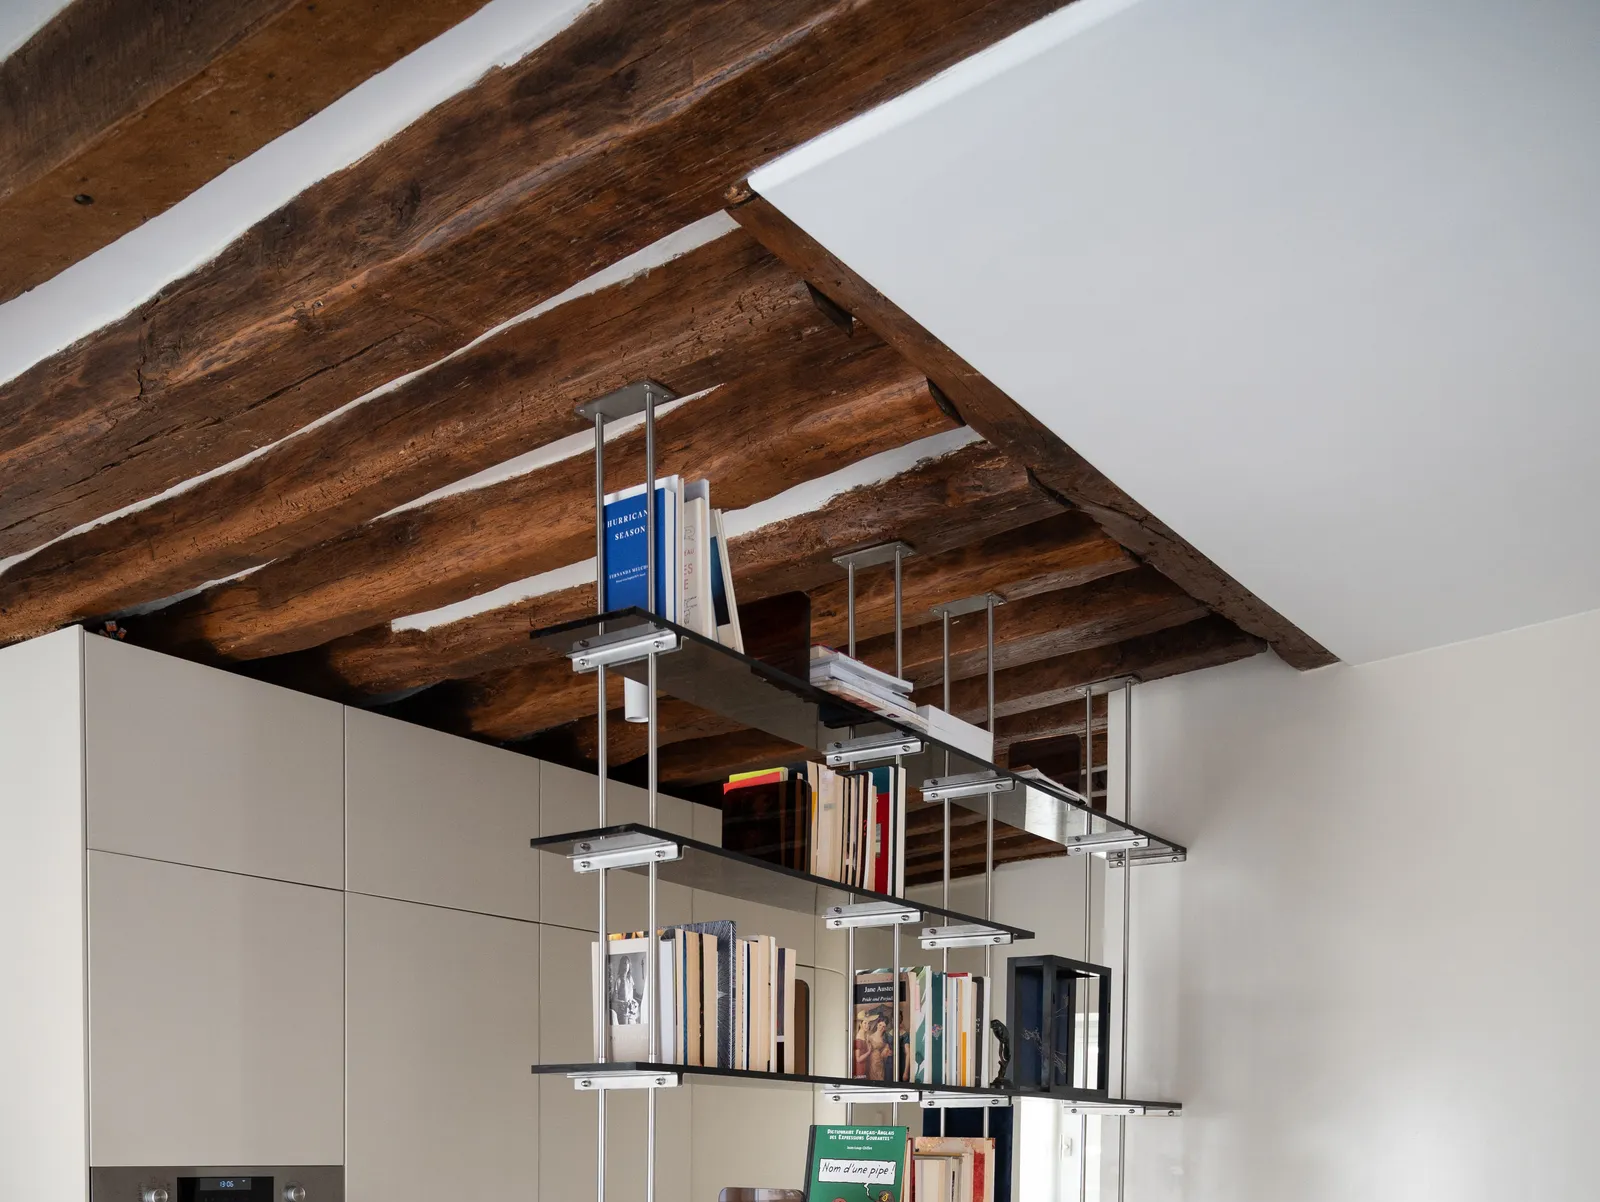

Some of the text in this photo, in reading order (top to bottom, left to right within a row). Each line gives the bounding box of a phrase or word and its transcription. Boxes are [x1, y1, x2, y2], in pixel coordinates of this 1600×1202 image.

[607, 509, 648, 528] HURRICAN
[615, 525, 646, 541] SEASON
[822, 1162, 841, 1173] Nom
[843, 1163, 867, 1174] d'une
[868, 1164, 889, 1178] pipe
